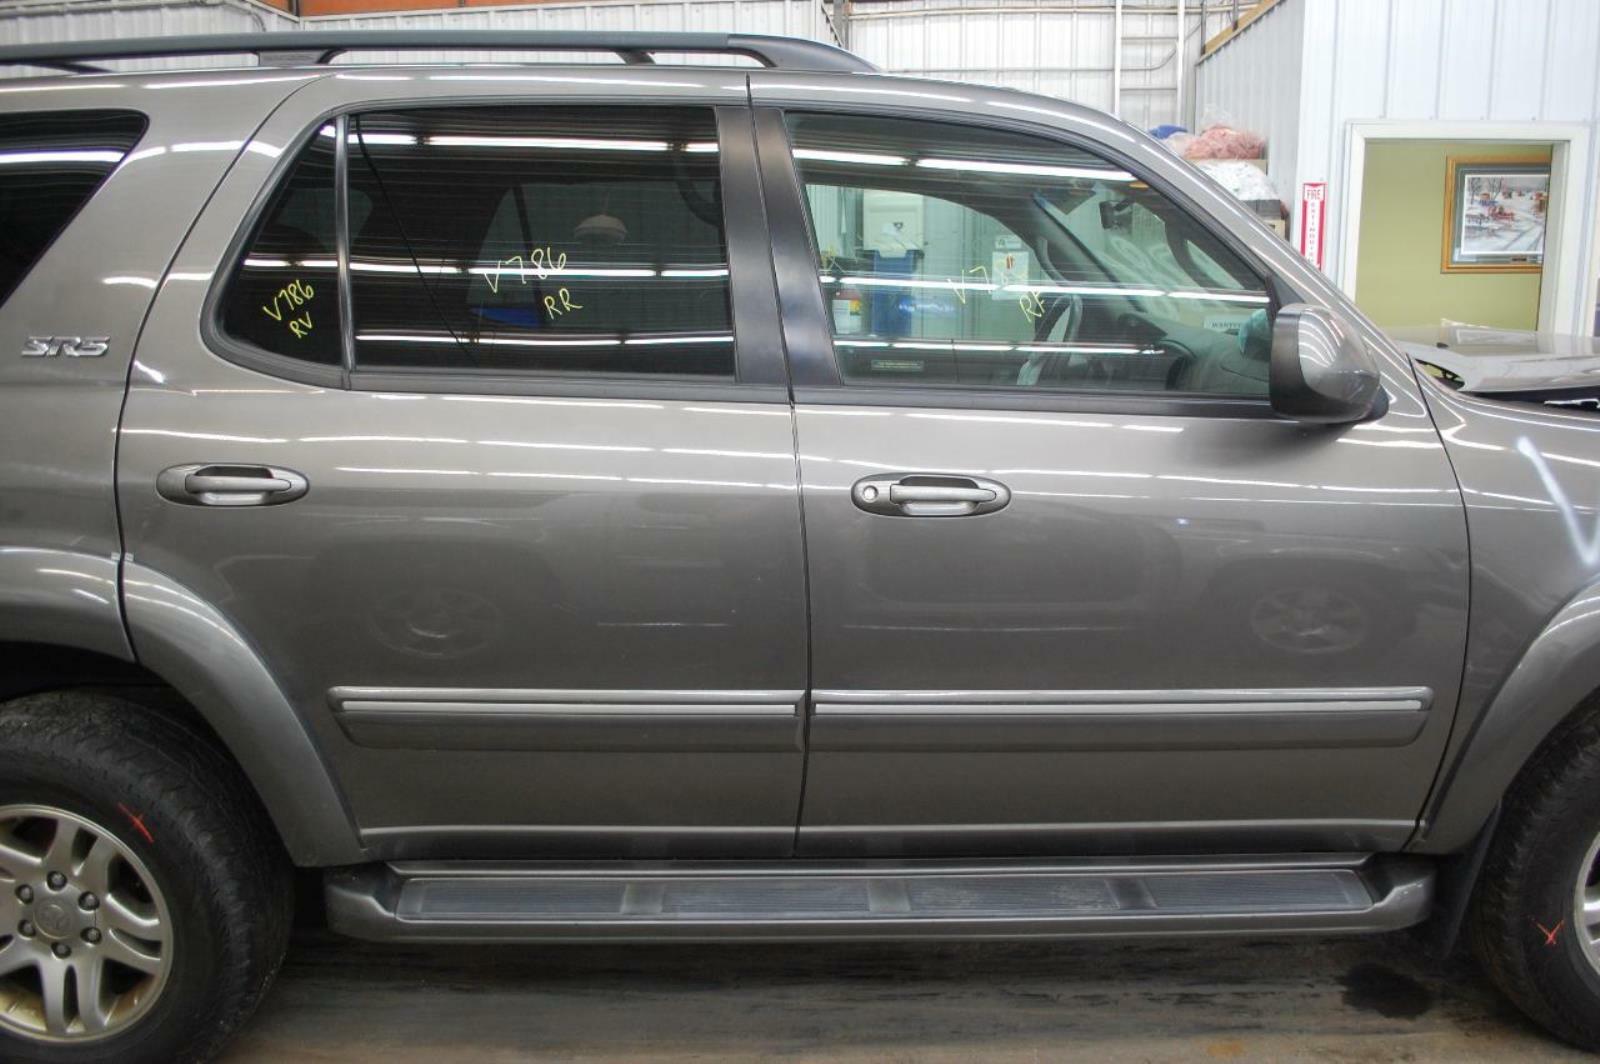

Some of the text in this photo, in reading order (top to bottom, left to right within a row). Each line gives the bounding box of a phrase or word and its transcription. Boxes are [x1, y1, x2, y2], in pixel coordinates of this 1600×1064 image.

[1306, 189, 1321, 200] FIRE
[483, 247, 567, 294] V786
[262, 279, 315, 321] V786
[544, 288, 584, 320] RR
[289, 311, 313, 339] RV
